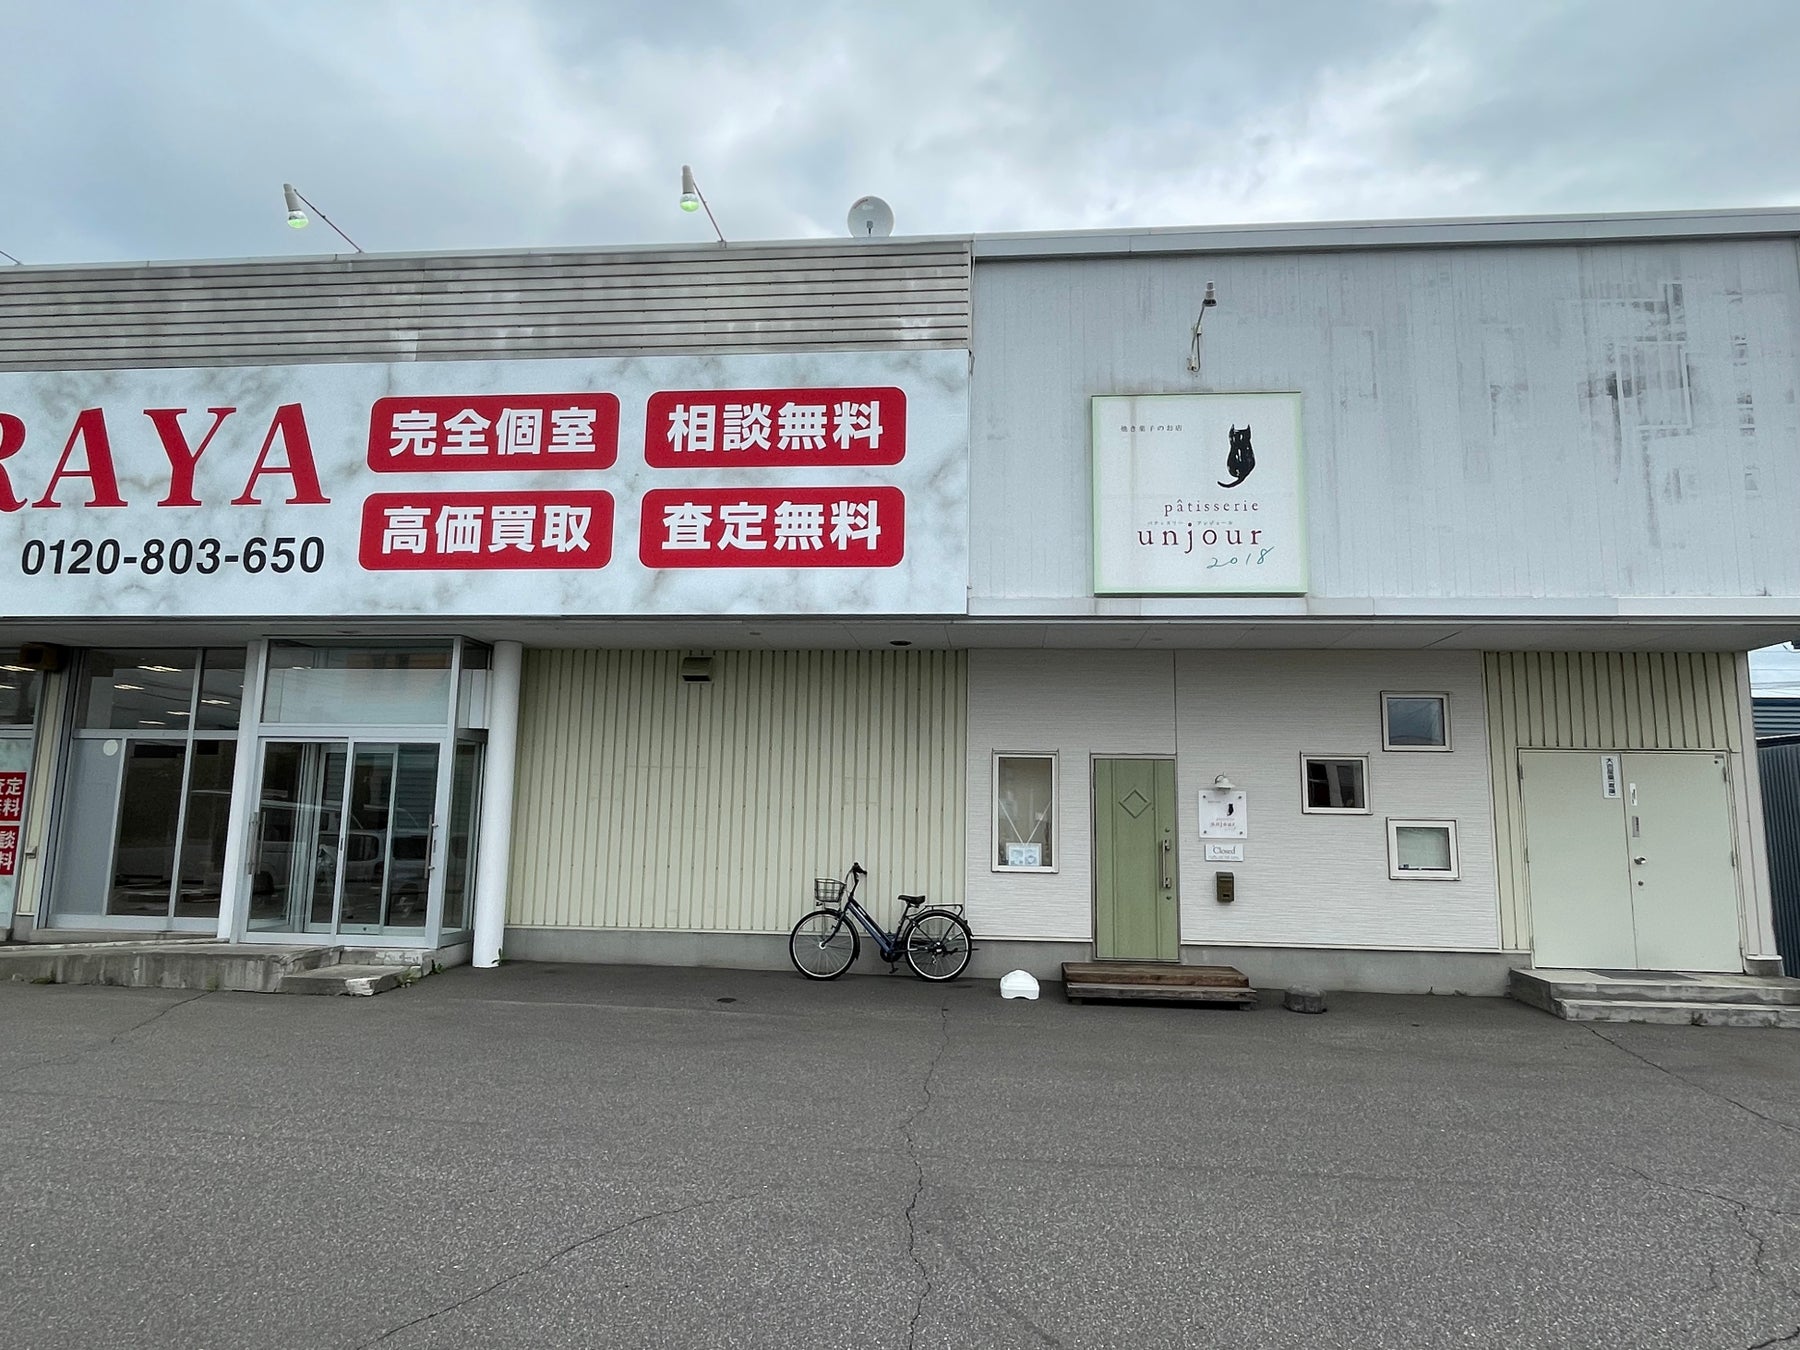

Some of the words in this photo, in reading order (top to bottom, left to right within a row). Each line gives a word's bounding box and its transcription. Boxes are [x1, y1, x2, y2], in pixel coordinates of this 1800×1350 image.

[388, 407, 598, 457] 完全個室
[666, 401, 884, 452] 相談無料
[0, 403, 331, 512] AYA
[381, 504, 593, 554] 高価買取
[661, 500, 883, 552] 査定無料
[1164, 498, 1260, 517] pâtisserie
[21, 536, 326, 576] 0120-803-650
[1137, 522, 1263, 554] unjour
[1206, 546, 1276, 569] 2018
